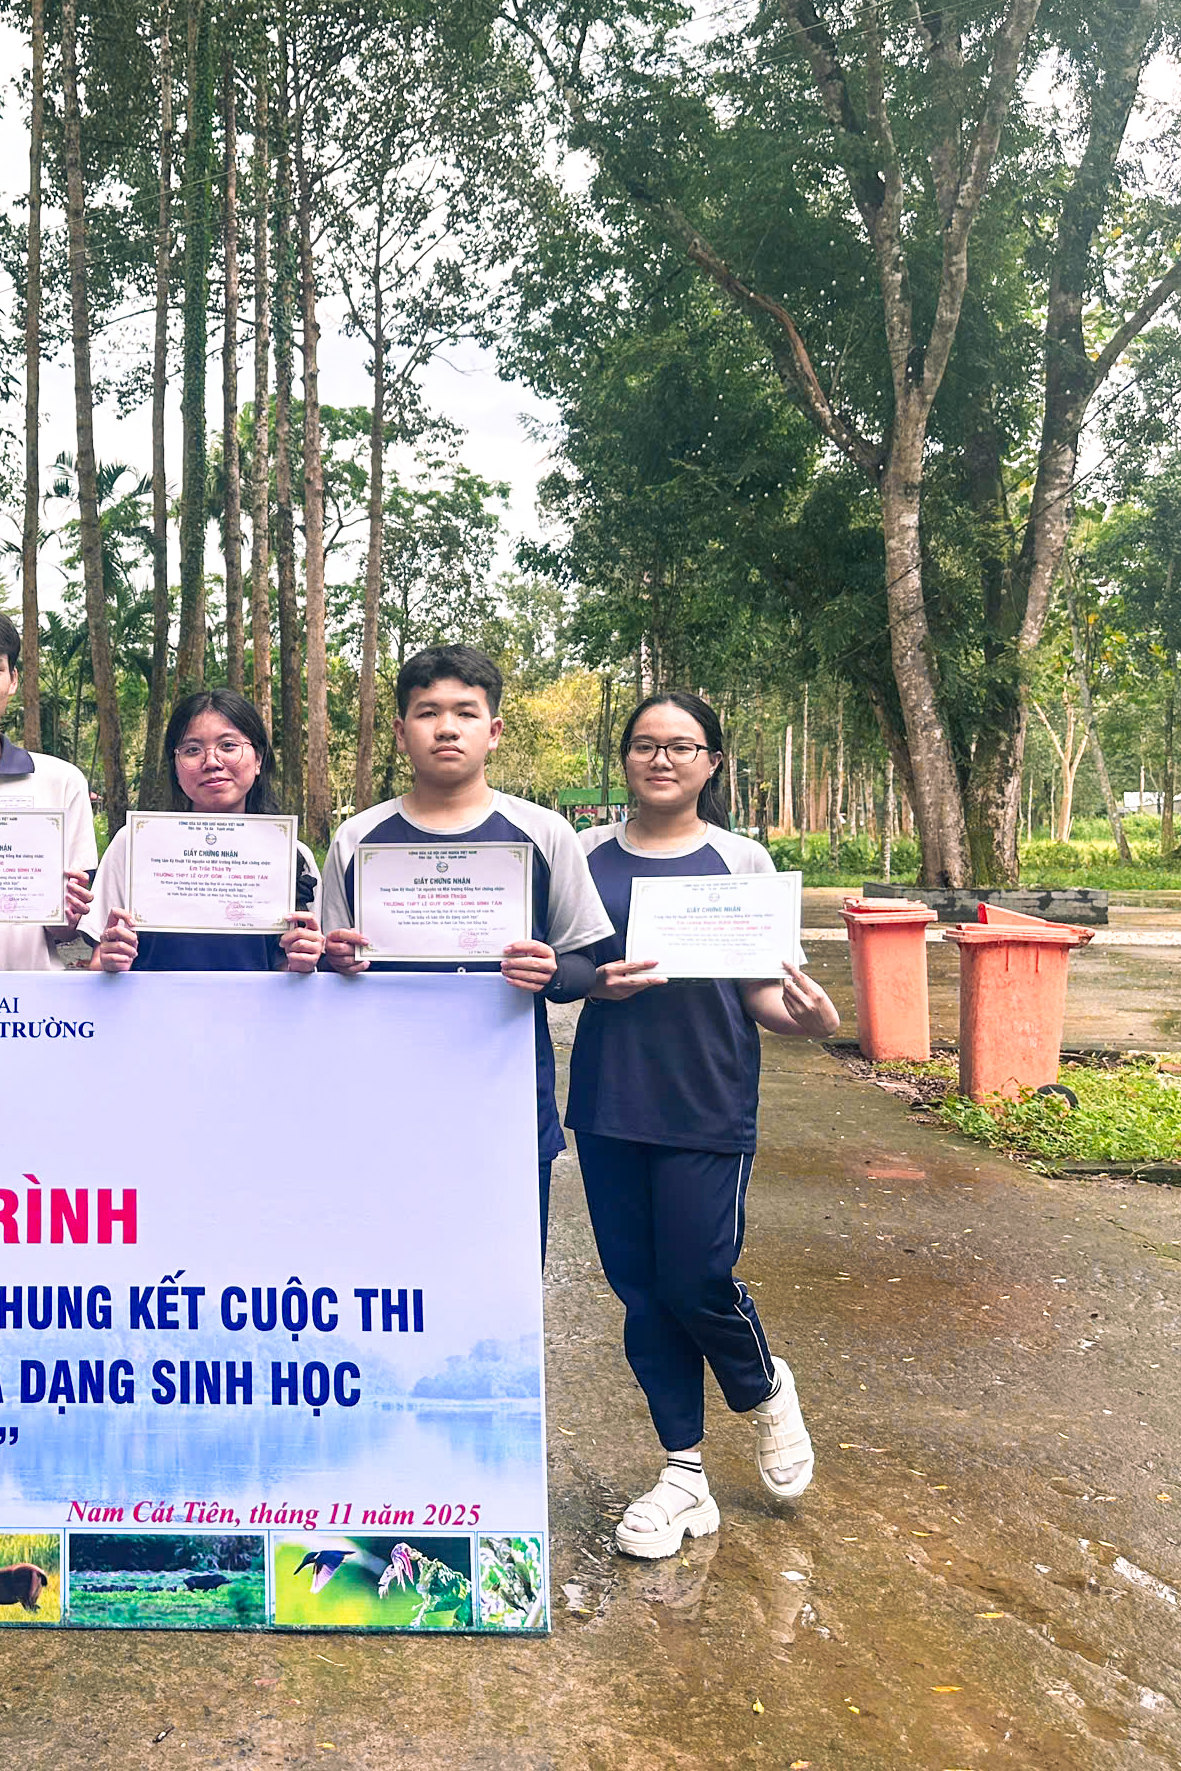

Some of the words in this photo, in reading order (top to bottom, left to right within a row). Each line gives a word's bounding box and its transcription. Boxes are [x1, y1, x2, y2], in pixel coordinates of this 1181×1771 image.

[130, 1270, 205, 1329] KẾT
[221, 1276, 338, 1341] CUỘC
[354, 1288, 423, 1332] THI
[21, 1359, 134, 1414] DẠNG
[152, 1360, 252, 1404] SINH
[271, 1361, 360, 1416] HỌC
[66, 1501, 124, 1523] Nam
[133, 1501, 174, 1522] Cát
[184, 1502, 240, 1527] Tiên,
[250, 1503, 319, 1530] tháng
[330, 1504, 352, 1524] 11
[362, 1504, 414, 1524] năm
[423, 1504, 480, 1525] 2025
